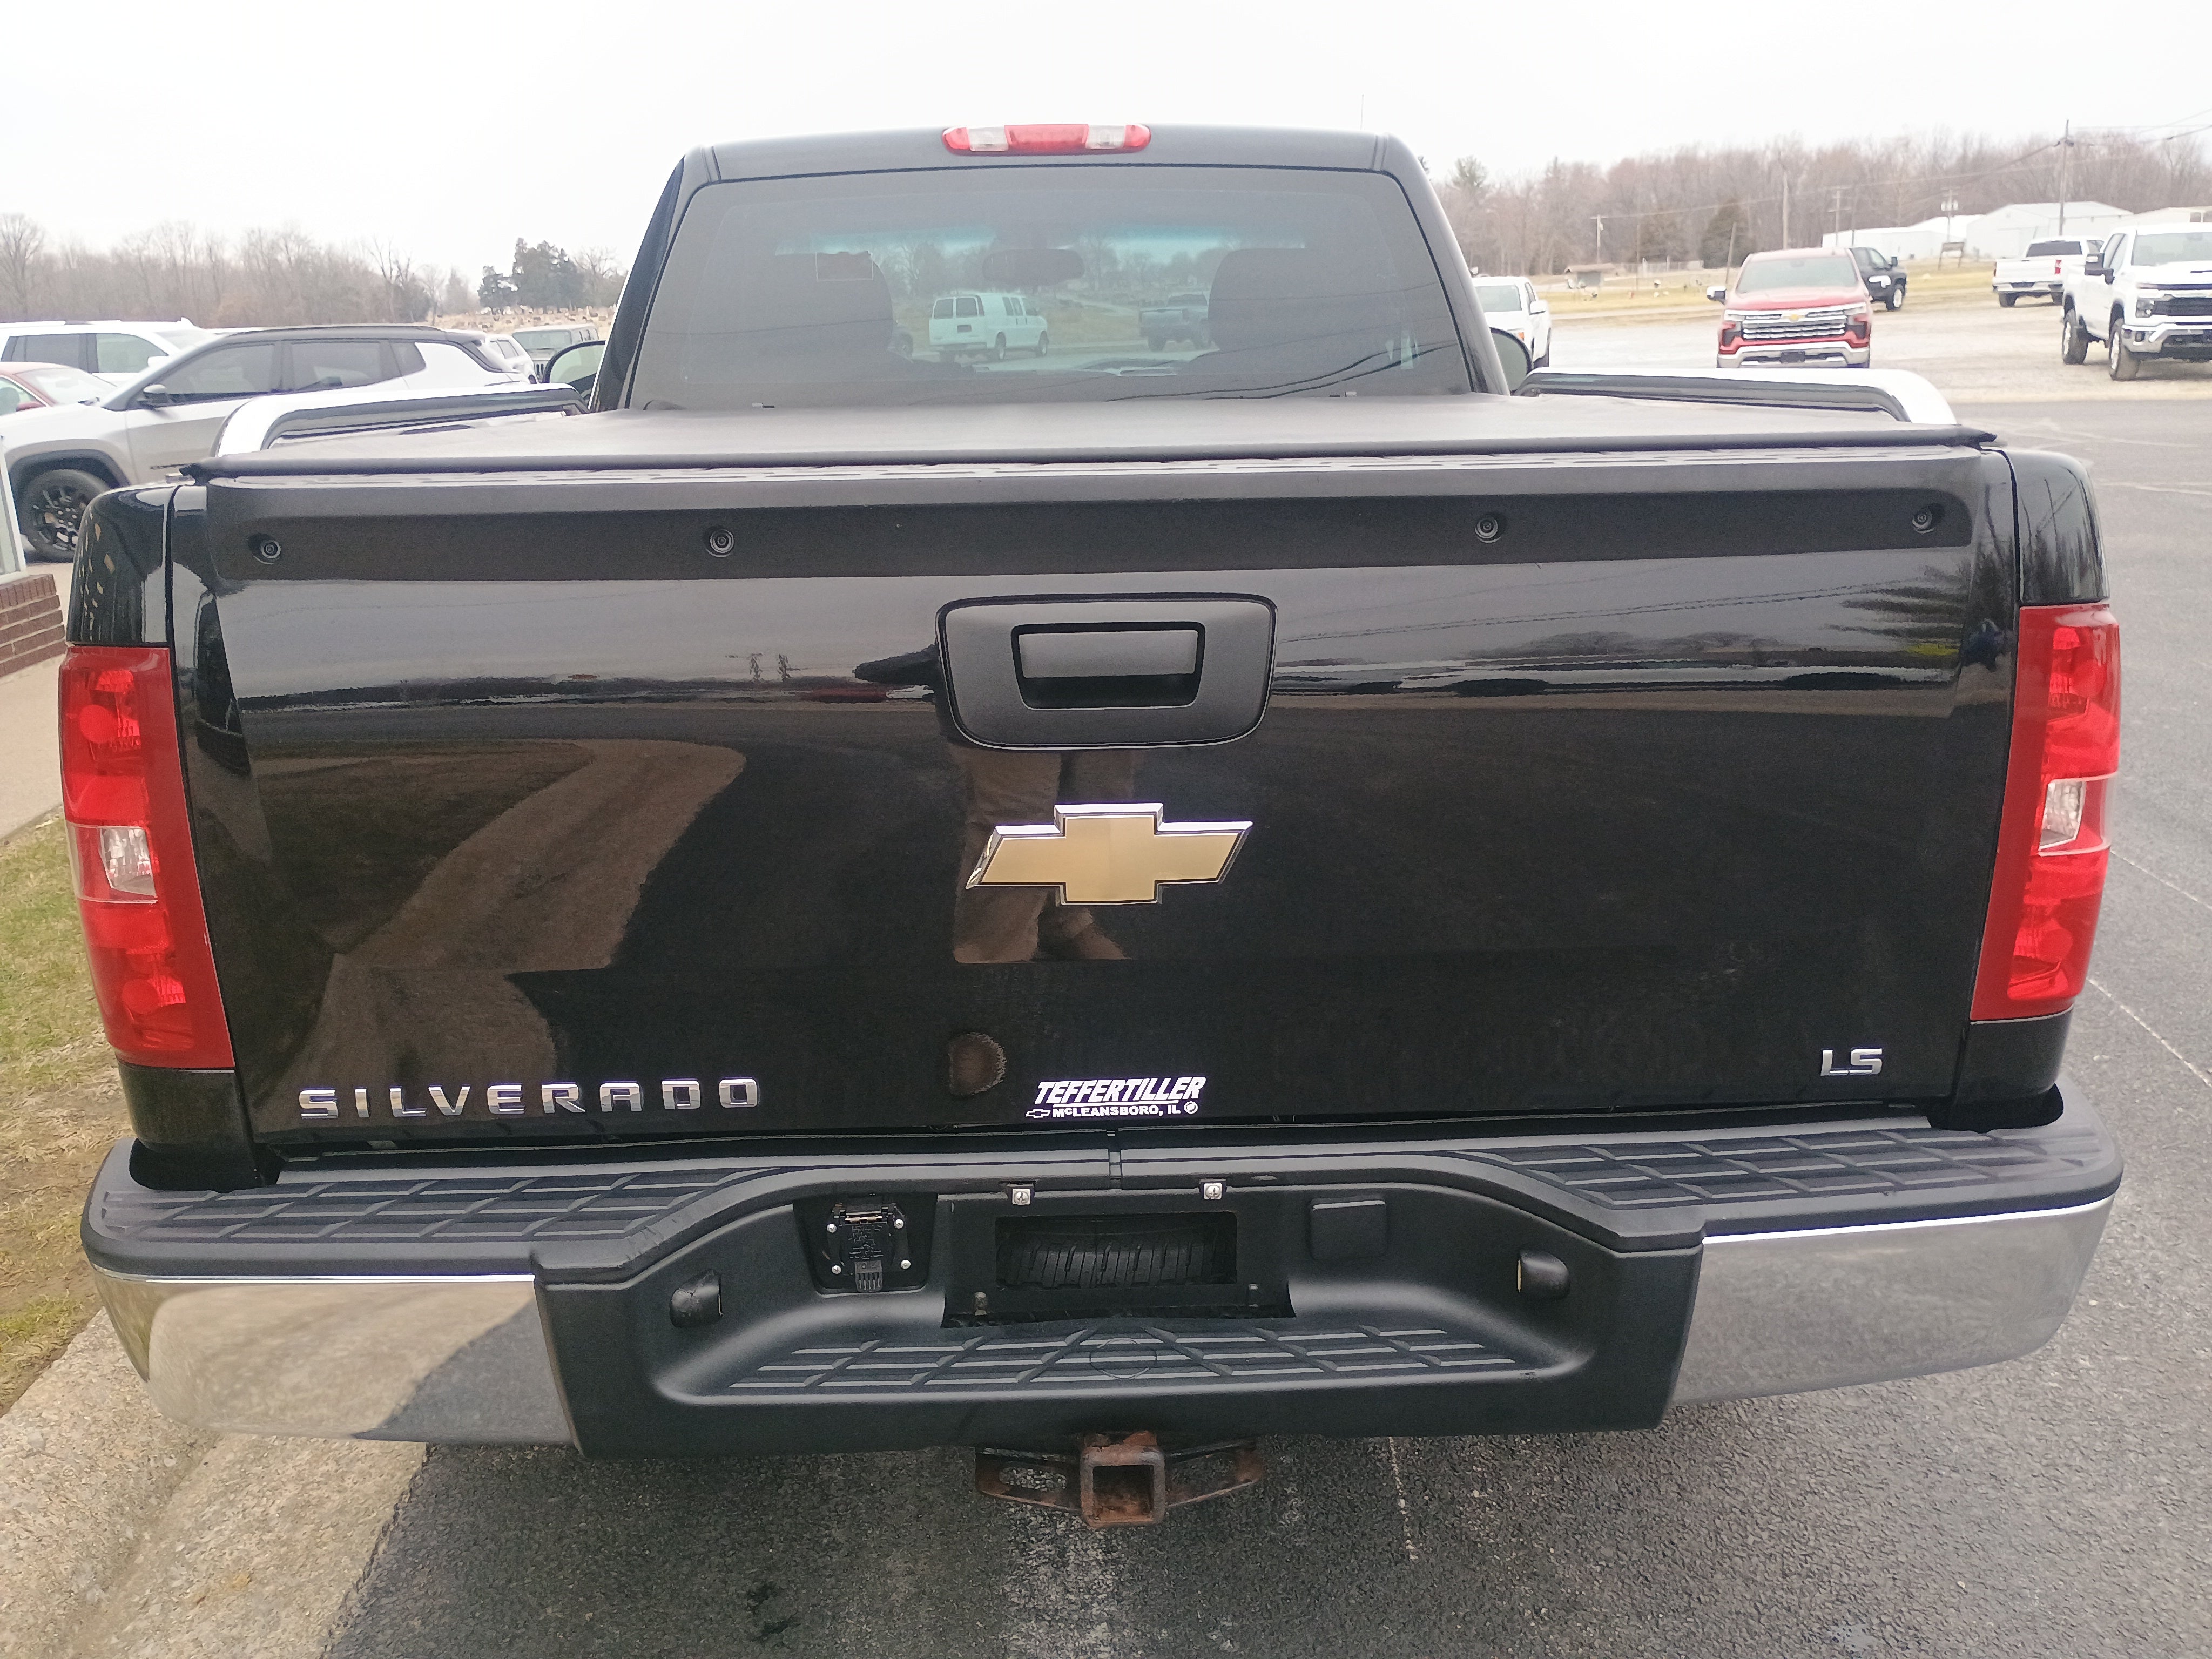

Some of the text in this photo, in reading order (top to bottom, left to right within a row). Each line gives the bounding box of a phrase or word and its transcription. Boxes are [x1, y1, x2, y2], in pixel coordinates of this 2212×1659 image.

[1820, 1048, 1883, 1076] LS
[298, 1078, 758, 1120] SILVERADO
[1034, 1076, 1206, 1104] TEFFERTILLER
[1167, 1104, 1181, 1114] IL
